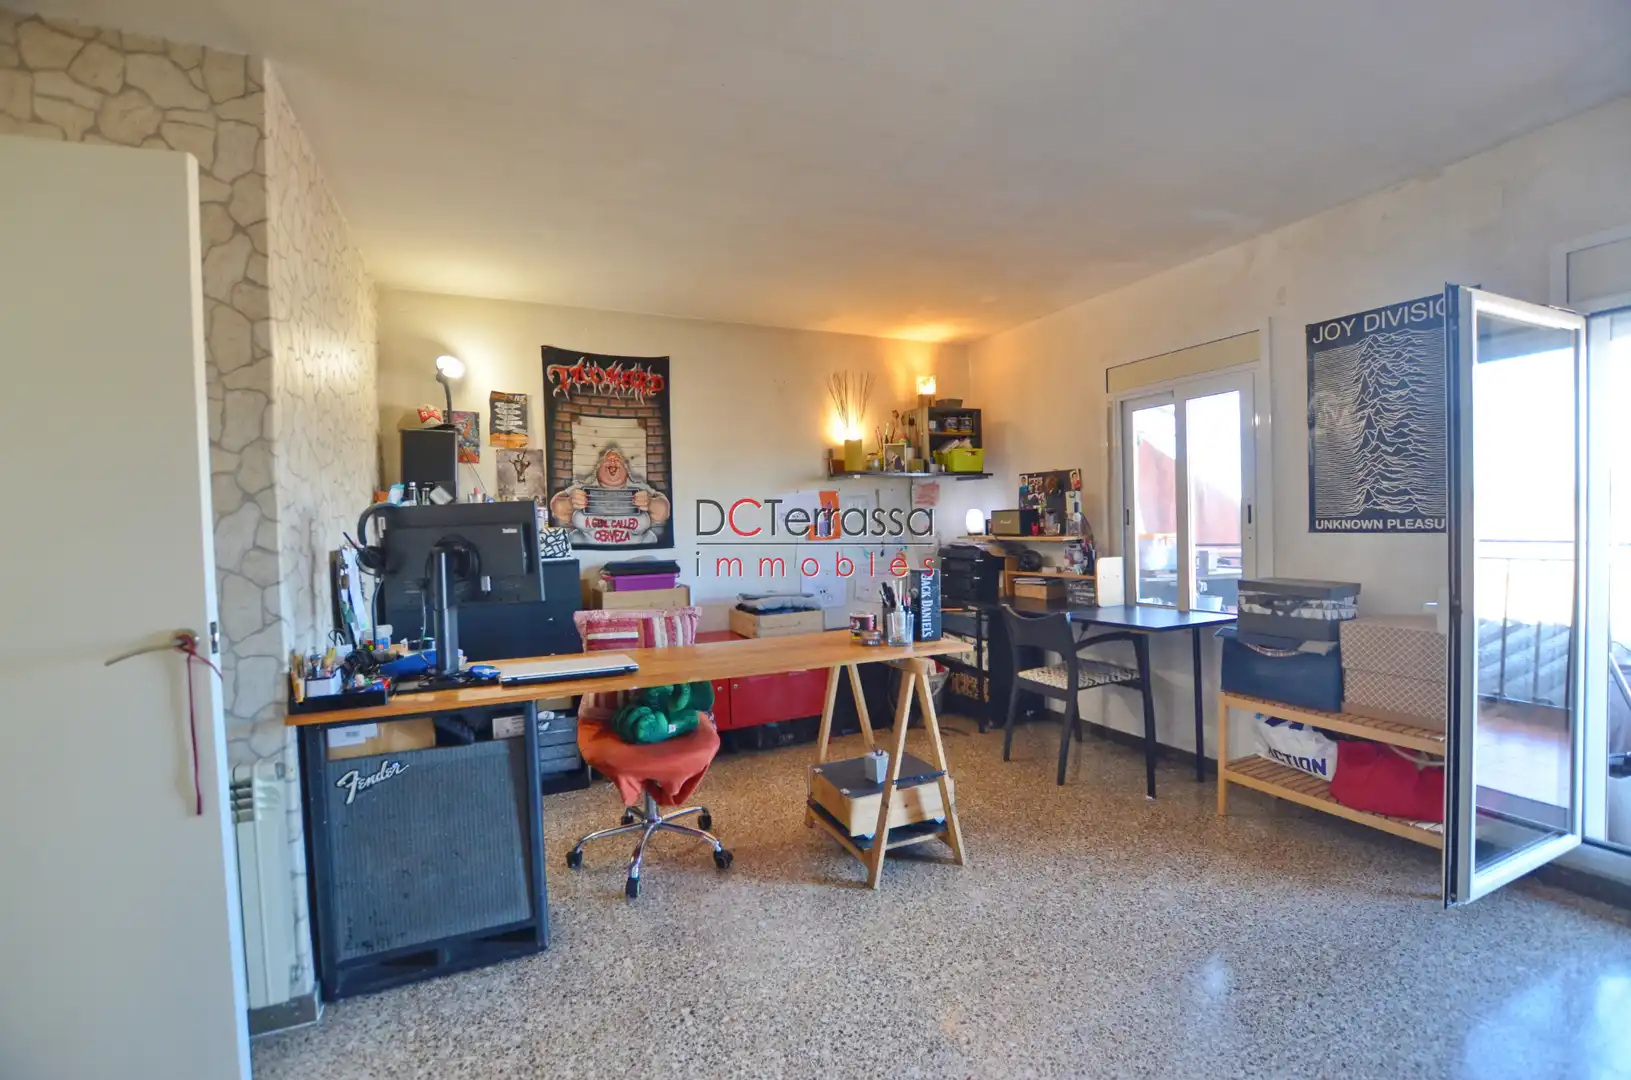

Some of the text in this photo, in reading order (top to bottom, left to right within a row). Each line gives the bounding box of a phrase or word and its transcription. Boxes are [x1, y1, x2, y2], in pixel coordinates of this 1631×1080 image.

[1312, 298, 1445, 344] JOY DIVISI
[547, 356, 665, 406] TANKARD
[585, 517, 592, 529] A
[610, 517, 639, 530] CALLED
[594, 529, 631, 543] CERVEZA
[1315, 517, 1445, 531] UNKNOWN PLEASU
[920, 572, 933, 598] JACK
[336, 759, 411, 805] Fender
